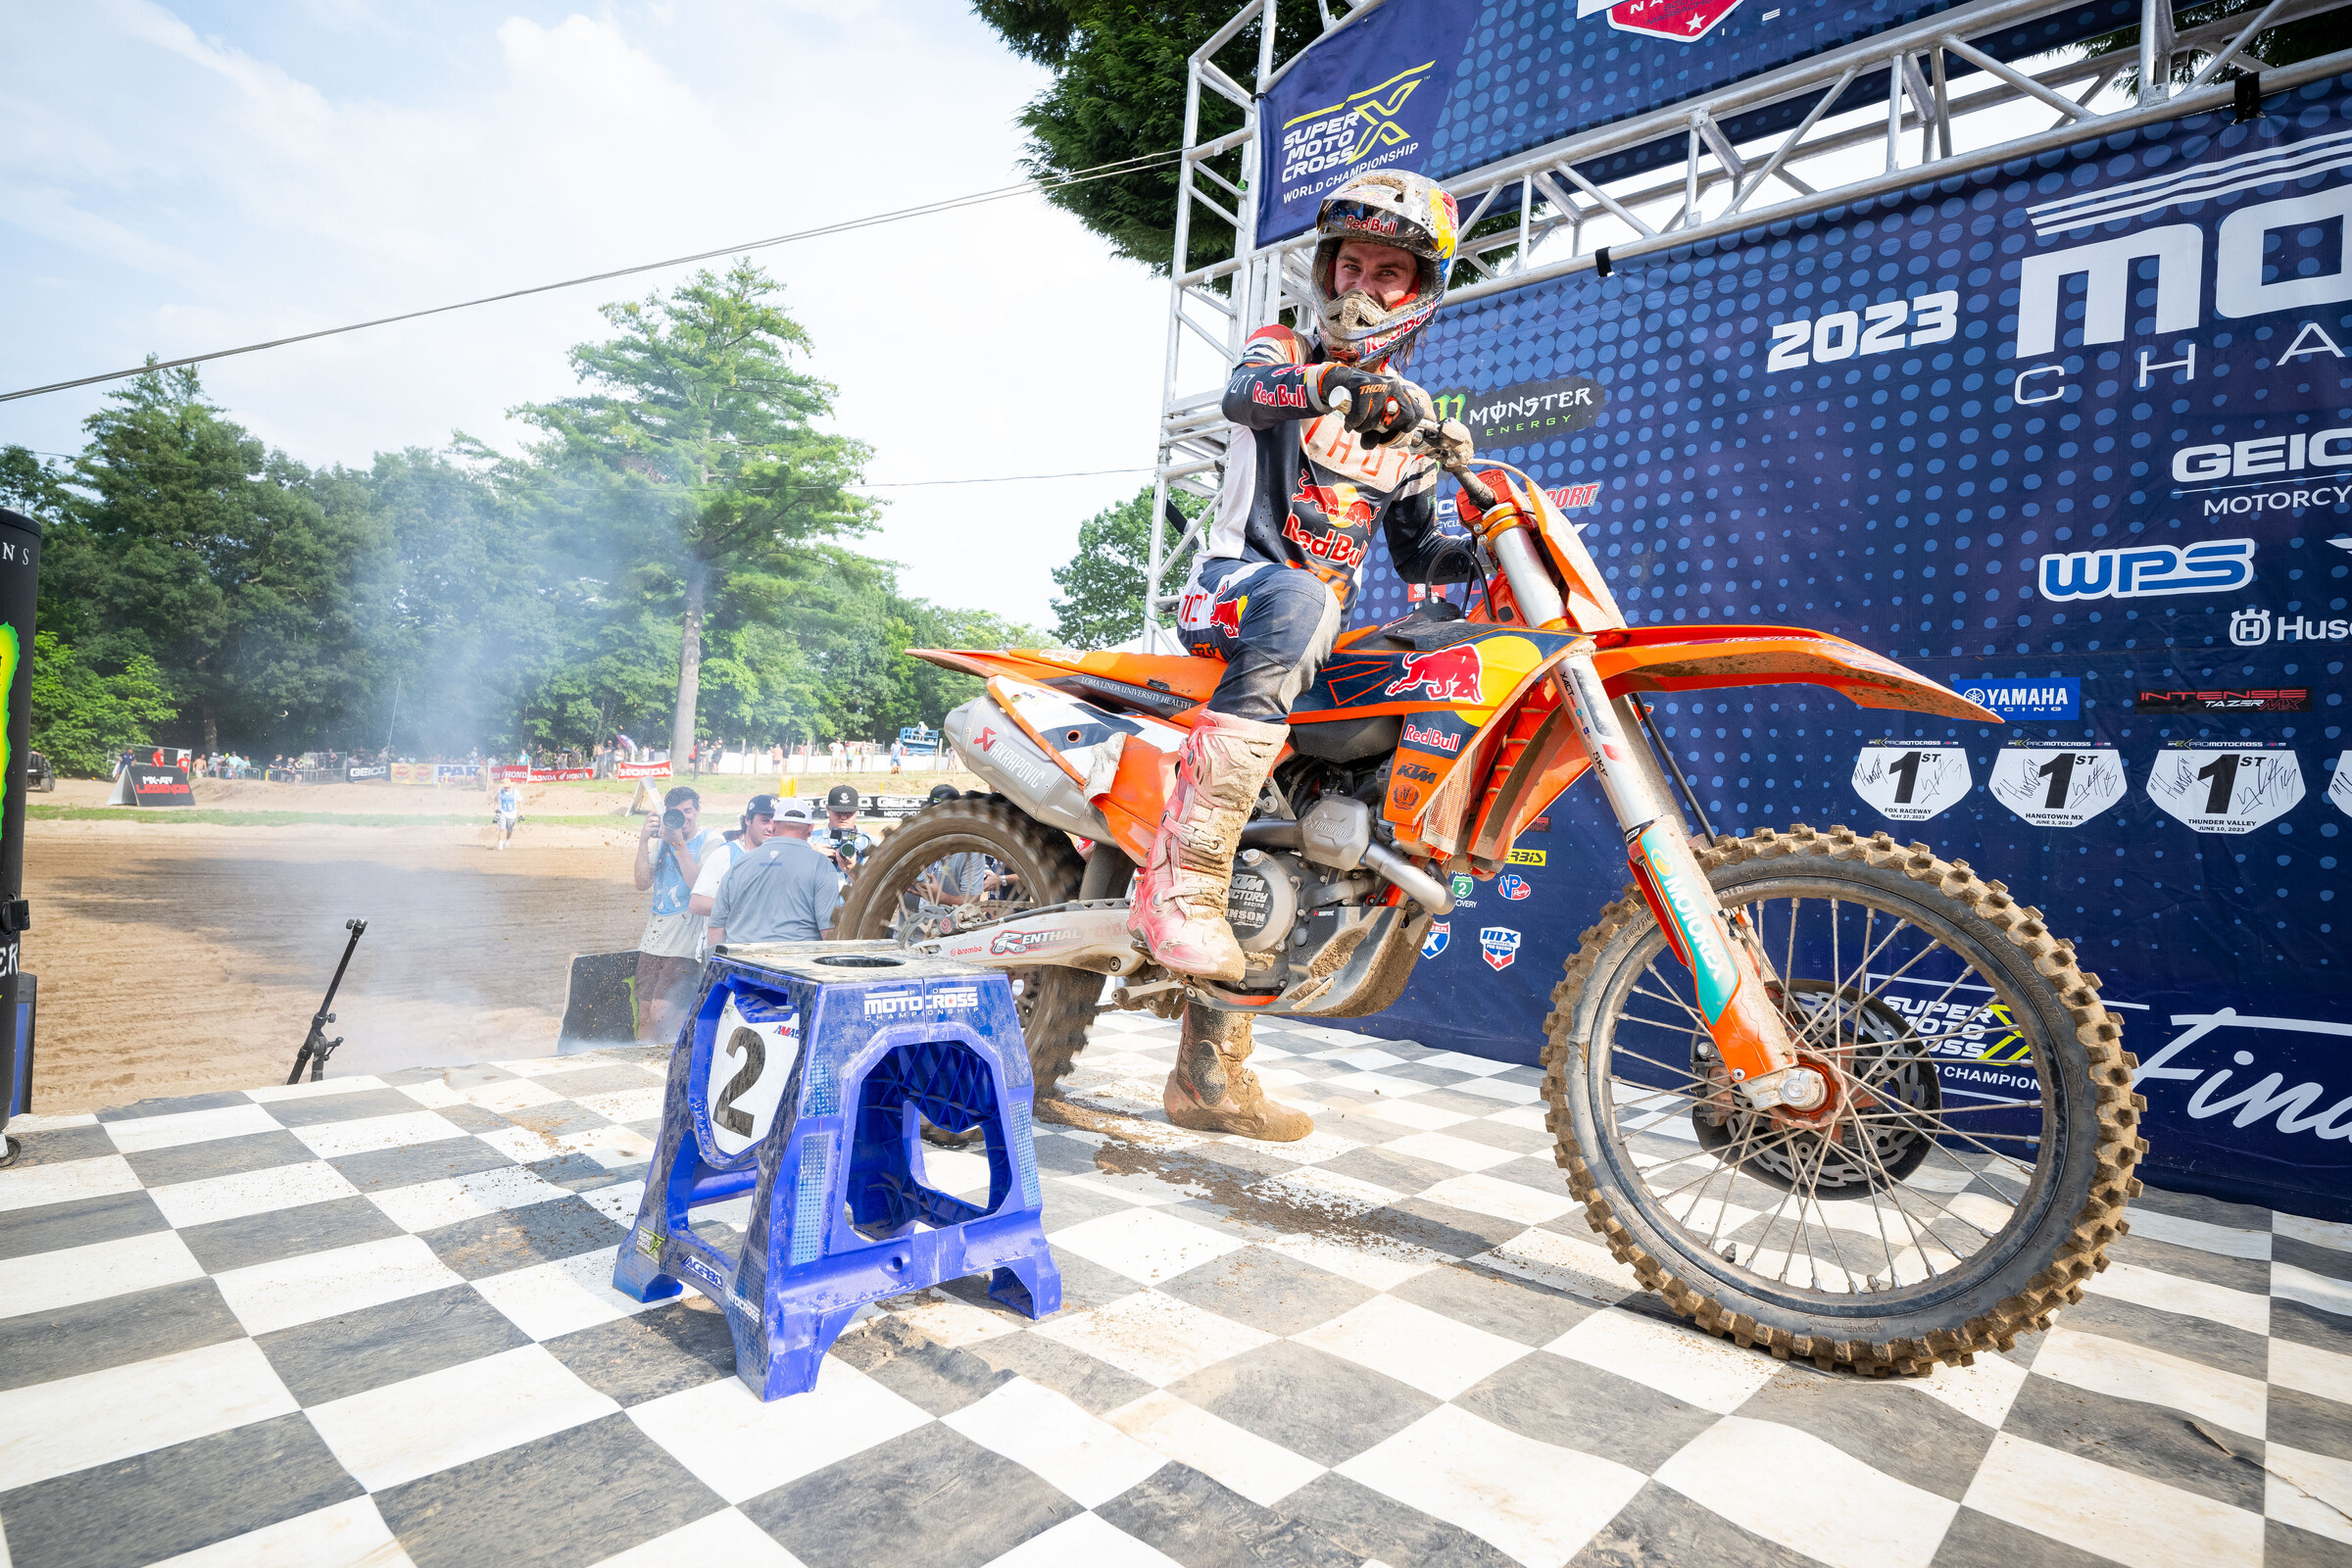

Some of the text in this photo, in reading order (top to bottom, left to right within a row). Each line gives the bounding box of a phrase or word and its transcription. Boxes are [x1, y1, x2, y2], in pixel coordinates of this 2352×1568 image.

[1282, 112, 1360, 151] SUPER
[1286, 128, 1354, 166] MOTO
[1281, 145, 1356, 183] CROSS
[1283, 142, 1419, 204] WORLD CHAMPIONSHIP
[1370, 219, 1397, 236] Bull
[1767, 290, 1958, 372] 2023
[1252, 380, 1277, 407] Red
[1276, 384, 1307, 409] Bull
[1359, 384, 1388, 395] THOR
[1486, 414, 1571, 436] ENERGY
[2204, 485, 2352, 516] MOTORCY
[1282, 509, 1369, 570] Red Bull
[2042, 541, 2252, 600] WPS
[1413, 590, 1440, 599] HODA
[2278, 616, 2352, 641] Hus
[1081, 676, 1192, 710] LOMA LINDA UNIVERSITY HEALTH
[1986, 688, 2069, 706] YAMAHA
[2141, 689, 2307, 701] INTENSE
[1403, 724, 1461, 753] Red Bull
[350, 765, 386, 777] GEICO
[619, 767, 670, 777] HONDA
[1396, 762, 1438, 785] KTM
[1592, 751, 1608, 778] SKF
[1232, 873, 1265, 892] KTM
[1457, 883, 1467, 895] 2
[1500, 874, 1521, 899] VP
[1228, 889, 1268, 903] ACTORY
[1225, 907, 1266, 922] INSON
[1663, 876, 1724, 981] MOTOREX
[957, 945, 983, 956] brembo
[863, 993, 978, 1015] MOTOCROSS
[864, 1006, 979, 1022] CHAMPIONSHIP
[1883, 995, 1996, 1024] SUPER
[712, 1025, 766, 1139] 2
